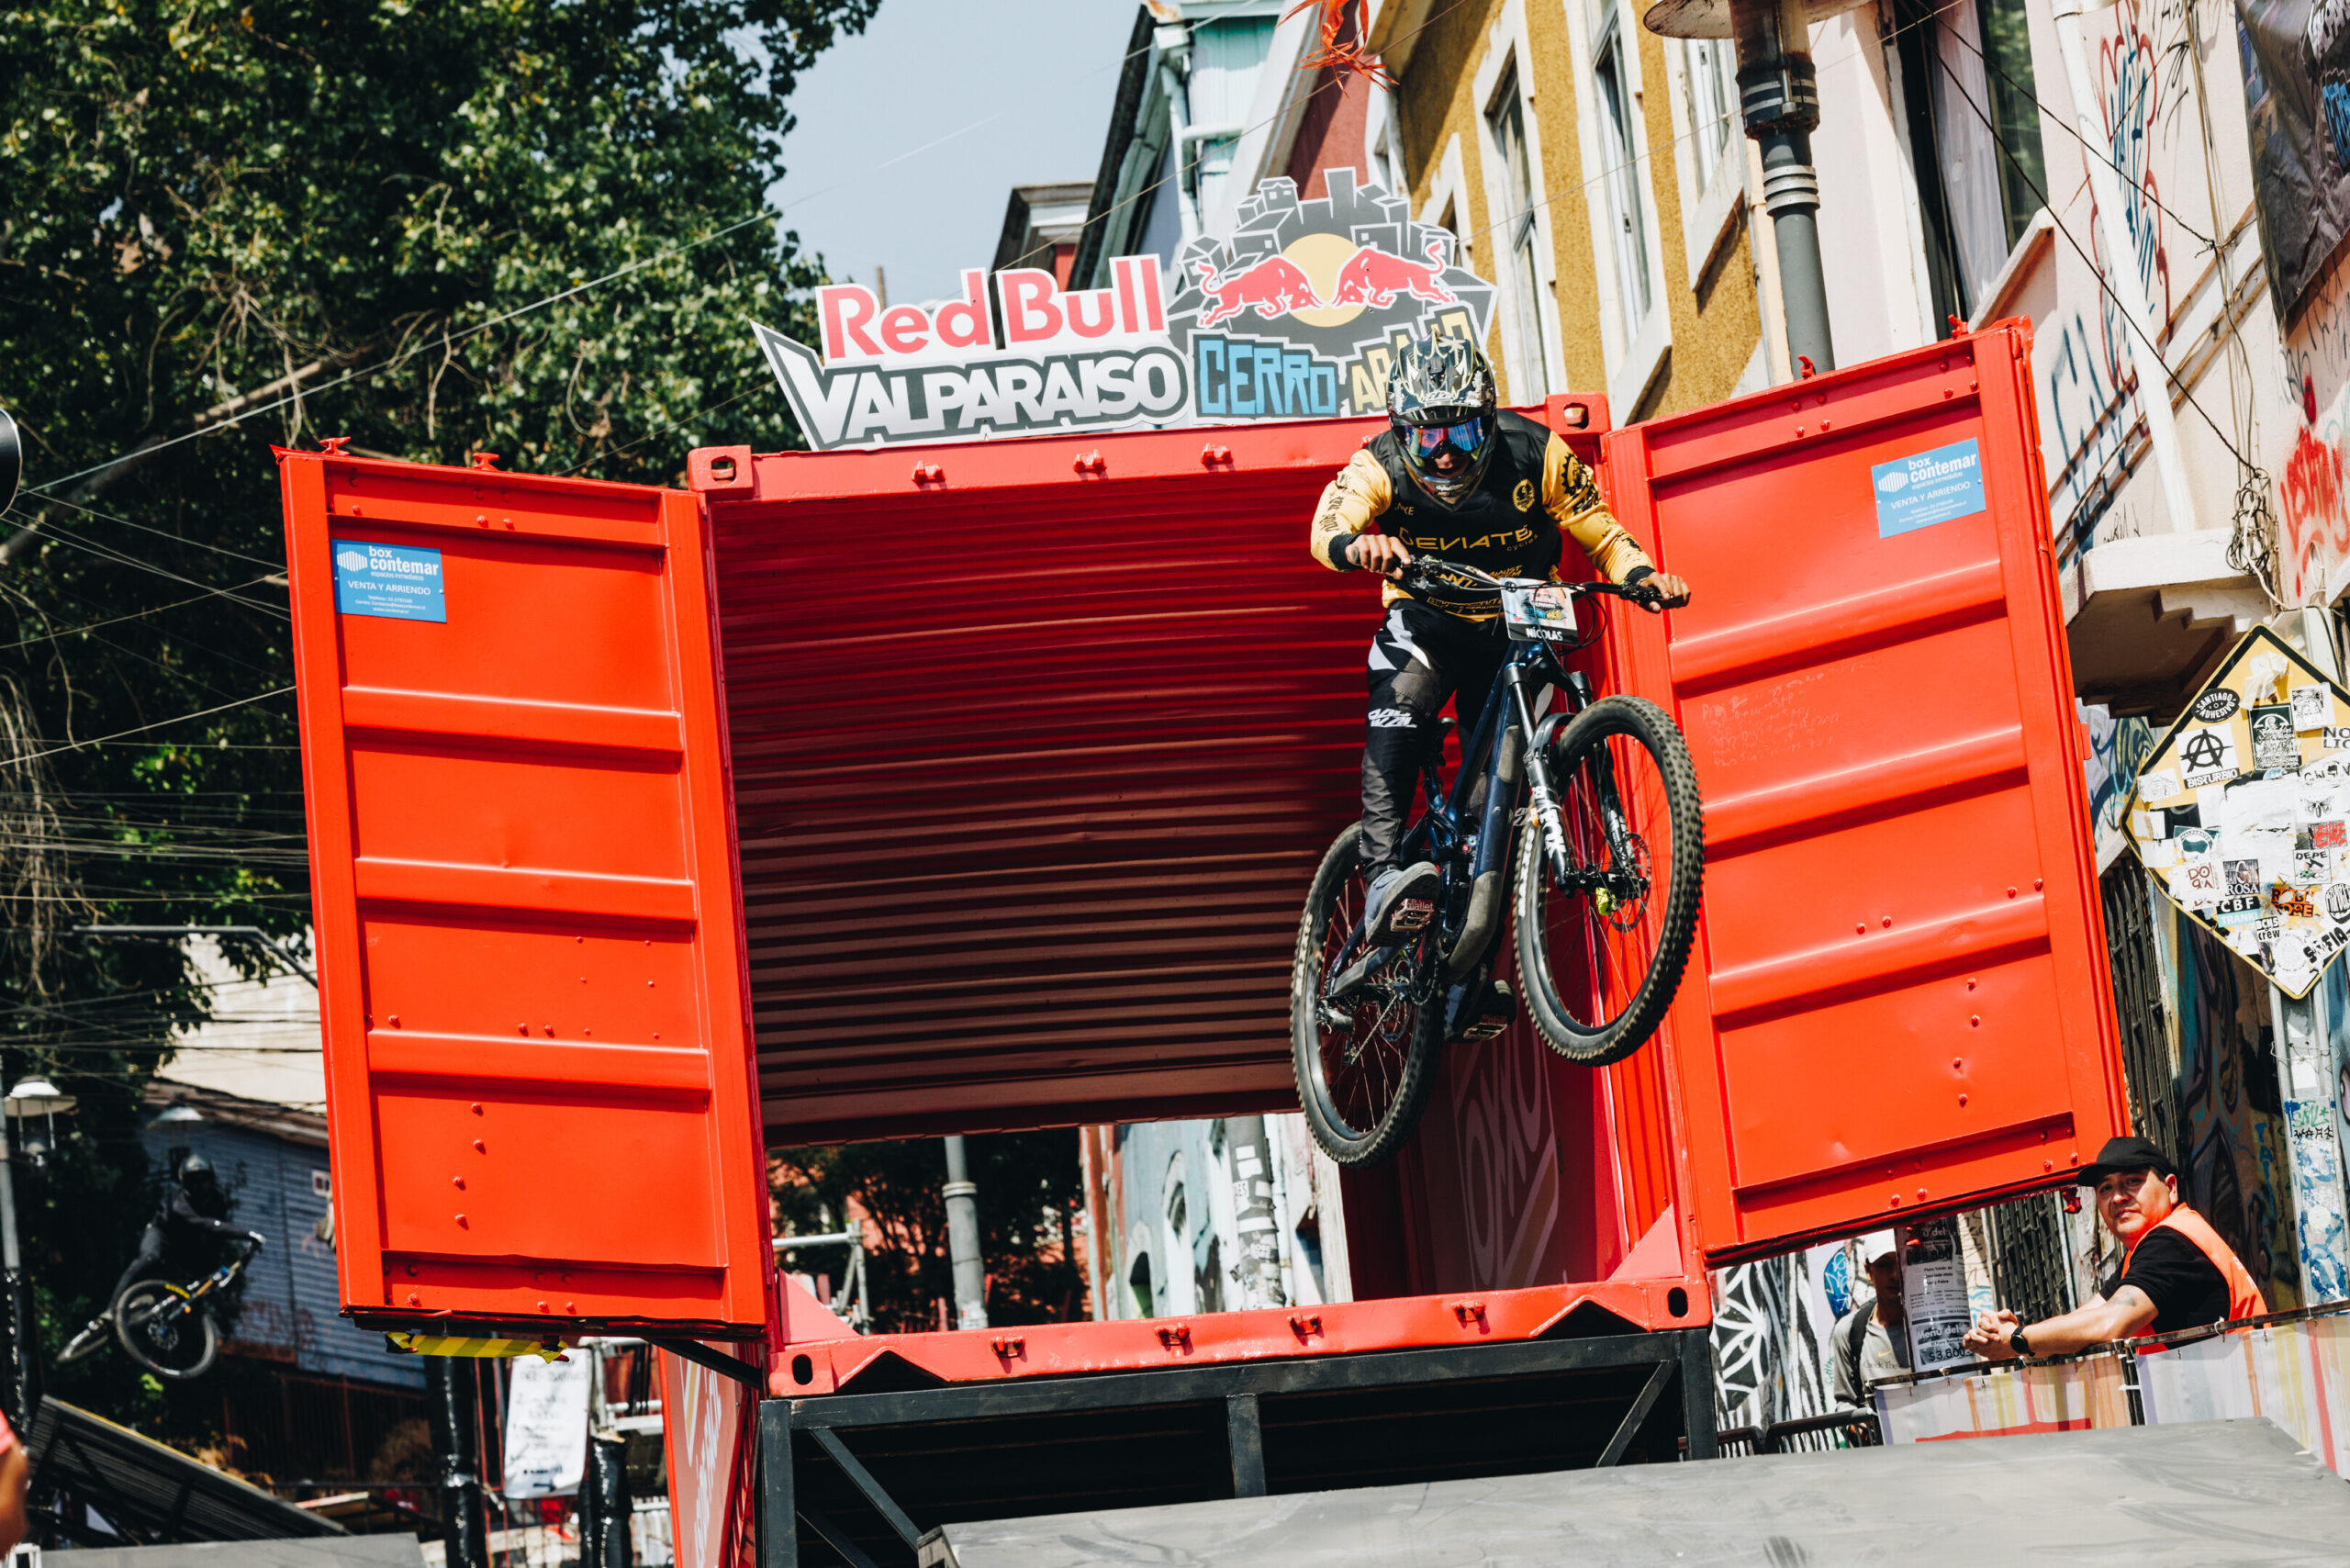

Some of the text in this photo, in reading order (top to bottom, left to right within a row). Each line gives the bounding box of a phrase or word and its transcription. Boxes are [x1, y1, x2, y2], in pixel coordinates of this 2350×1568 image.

[822, 256, 1166, 360] Red Bull
[1197, 339, 1337, 416] CERRO
[762, 330, 1183, 446] VALPARAISO
[1908, 456, 1931, 471] box
[1910, 454, 1976, 483] contemar
[1891, 480, 1971, 510] VENTA Y ARRIENDO
[368, 545, 393, 559] box
[369, 556, 440, 577] contemar
[347, 580, 431, 596] VENTA Y ARRIENDO
[2196, 691, 2233, 711] SANTIAGO
[2199, 700, 2236, 720] ADHESIVO
[2323, 726, 2350, 738] NO
[2295, 850, 2329, 861] DEPE
[2227, 883, 2259, 896] ROSA
[1405, 901, 1435, 913] mallet
[2221, 897, 2255, 913] CBF
[2258, 929, 2280, 941] crew
